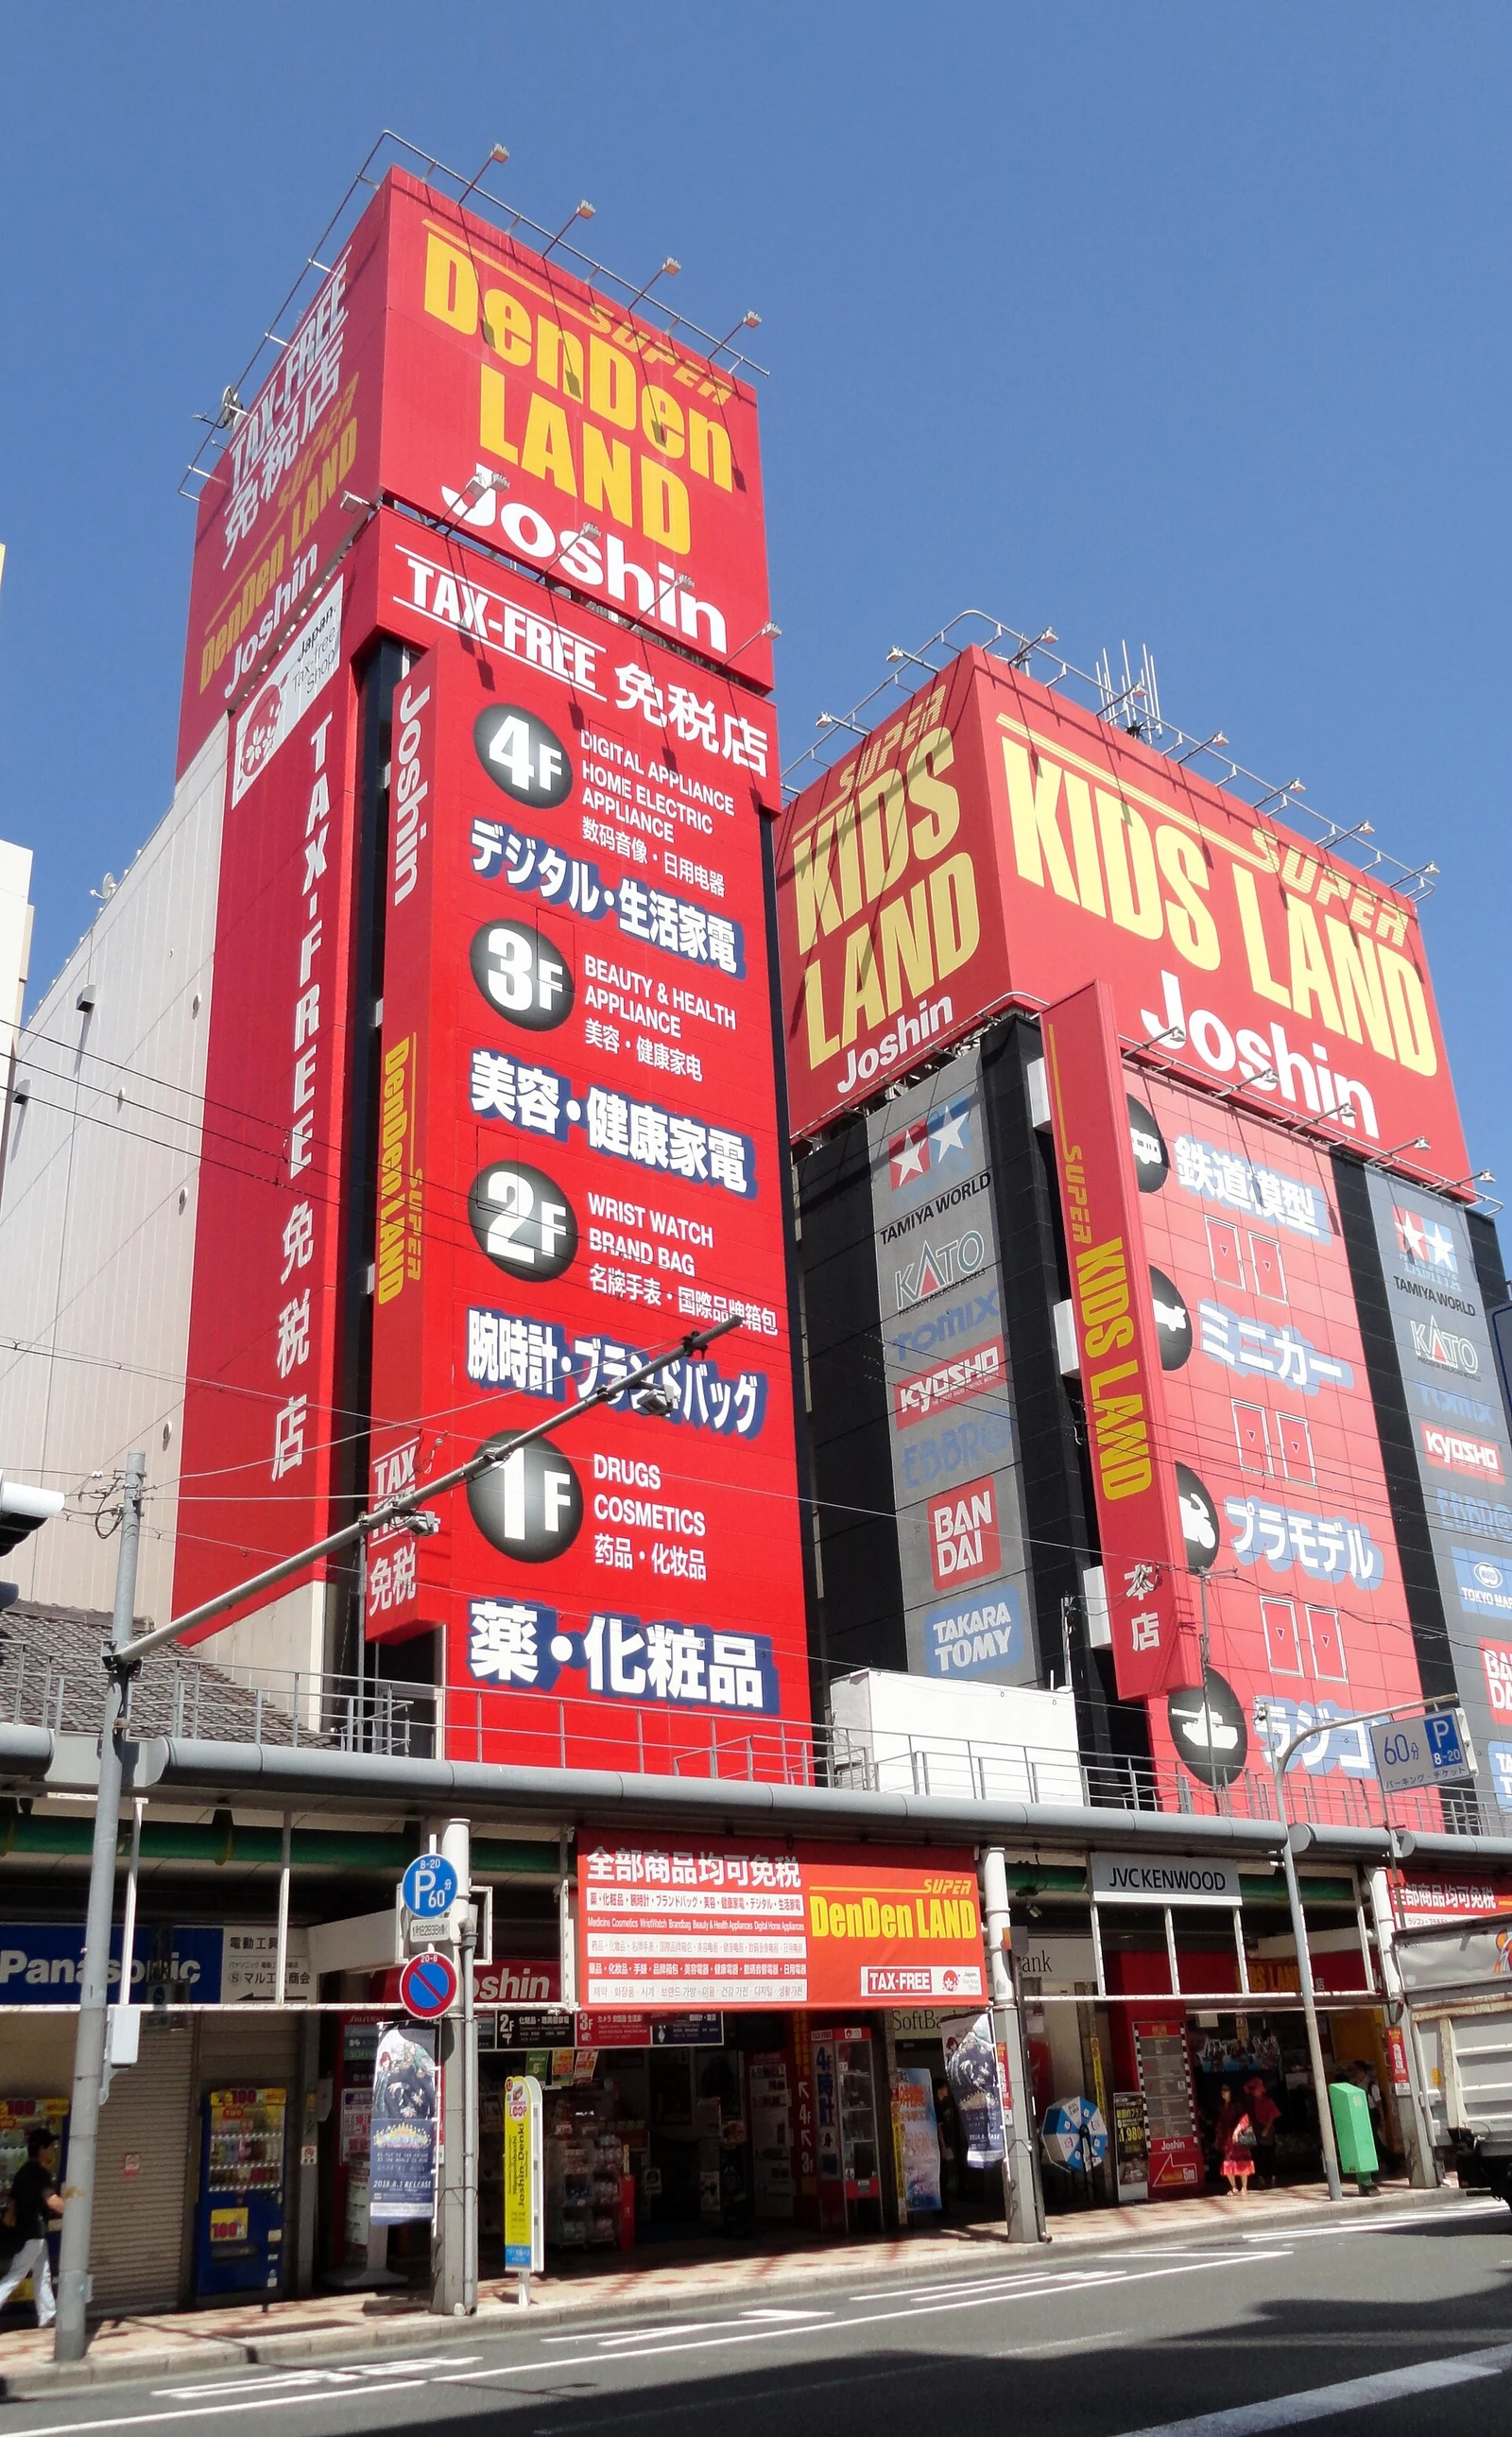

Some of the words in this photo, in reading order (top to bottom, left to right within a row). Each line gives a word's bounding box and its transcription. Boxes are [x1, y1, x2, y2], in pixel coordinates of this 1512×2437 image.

[232, 262, 347, 495] TAX-FREE
[425, 233, 732, 493] DenDen
[576, 304, 732, 406] SUPER
[223, 332, 343, 570] 免税店
[480, 364, 691, 555] LAND
[199, 534, 284, 695] DenDen
[290, 417, 357, 556] LAND
[441, 464, 727, 654] Joshin
[225, 544, 318, 700] Joshin
[407, 558, 596, 691] TAX-FREE
[489, 715, 562, 791] 4F
[614, 663, 767, 778] 免税店
[840, 684, 947, 798] SUPER
[395, 684, 430, 907] Joshin
[580, 729, 644, 775] DIGITAL
[648, 761, 734, 816] APPLIANCE
[582, 760, 631, 800] HOME
[636, 784, 713, 835] ELECTRIC
[582, 787, 675, 843] APPLIANCE
[792, 727, 960, 955] KIDS
[1001, 736, 1221, 972] KIDS
[1232, 862, 1437, 1077] LAND
[1251, 827, 1409, 947] SUPER
[488, 927, 562, 1011] 3F
[584, 954, 652, 998] BEAUTY
[657, 982, 668, 1005] &
[672, 988, 736, 1029] HEALTH
[803, 853, 980, 1070] LAND
[585, 985, 682, 1038] APPLIANCE
[836, 995, 954, 1094] Joshin
[1140, 970, 1379, 1139] Joshin
[381, 1036, 409, 1201] DenDen
[407, 1167, 422, 1280] SUPER
[488, 1170, 566, 1264] 2F
[588, 1192, 645, 1226] WRIST
[650, 1209, 713, 1248] WATCH
[880, 1202, 935, 1246] TAMIYA
[936, 1171, 992, 1215] WORLD
[1063, 1144, 1091, 1244] SUPER
[1174, 1135, 1320, 1236] 鉄道模型
[379, 1198, 406, 1305] LAND
[589, 1228, 653, 1264] BRAND
[658, 1247, 695, 1277] BAG
[895, 1230, 984, 1310] KATO
[1075, 1236, 1134, 1358] KIDS
[1393, 1275, 1437, 1304] TAMIYA
[1436, 1291, 1476, 1317] WORLD
[270, 1201, 314, 1482] 免税店
[1198, 1302, 1343, 1386] ミニカー
[1410, 1315, 1478, 1374] KATO
[374, 1445, 416, 1496] TAX
[593, 1453, 661, 1490] DRUGS
[1091, 1369, 1152, 1501] LAND
[1425, 1430, 1499, 1470] KYOSHO
[490, 1446, 571, 1540] 1F
[594, 1494, 705, 1537] COSMETICS
[934, 1490, 992, 1543] BAN
[369, 1542, 416, 1616] 免税
[936, 1530, 984, 1577] DAI
[1226, 1502, 1374, 1580] プラモデル
[933, 1601, 1011, 1644] TAKARA
[1461, 1587, 1494, 1605] TOKYO
[471, 1600, 764, 1708] 薬・化粧品
[935, 1626, 1012, 1671] TOMY
[1254, 1703, 1381, 1770] ラジコ
[1383, 1733, 1419, 1766] 60分
[1432, 1720, 1450, 1749] P
[1434, 1749, 1461, 1765] 8-20
[414, 1870, 436, 1910] P
[421, 1858, 440, 1869] 8-20
[587, 1846, 801, 1888] 全部商品均可免税
[923, 1878, 971, 1895] SUPER
[809, 1895, 914, 1938] DenDen
[915, 1898, 977, 1939] LAND
[421, 1954, 438, 1962] 20-8
[500, 2014, 514, 2032] 2F
[579, 2012, 593, 2031] 3F
[509, 2106, 527, 2117] LOOP
[1160, 2139, 1186, 2152] Joshin
[404, 2180, 433, 2189] RELEASE
